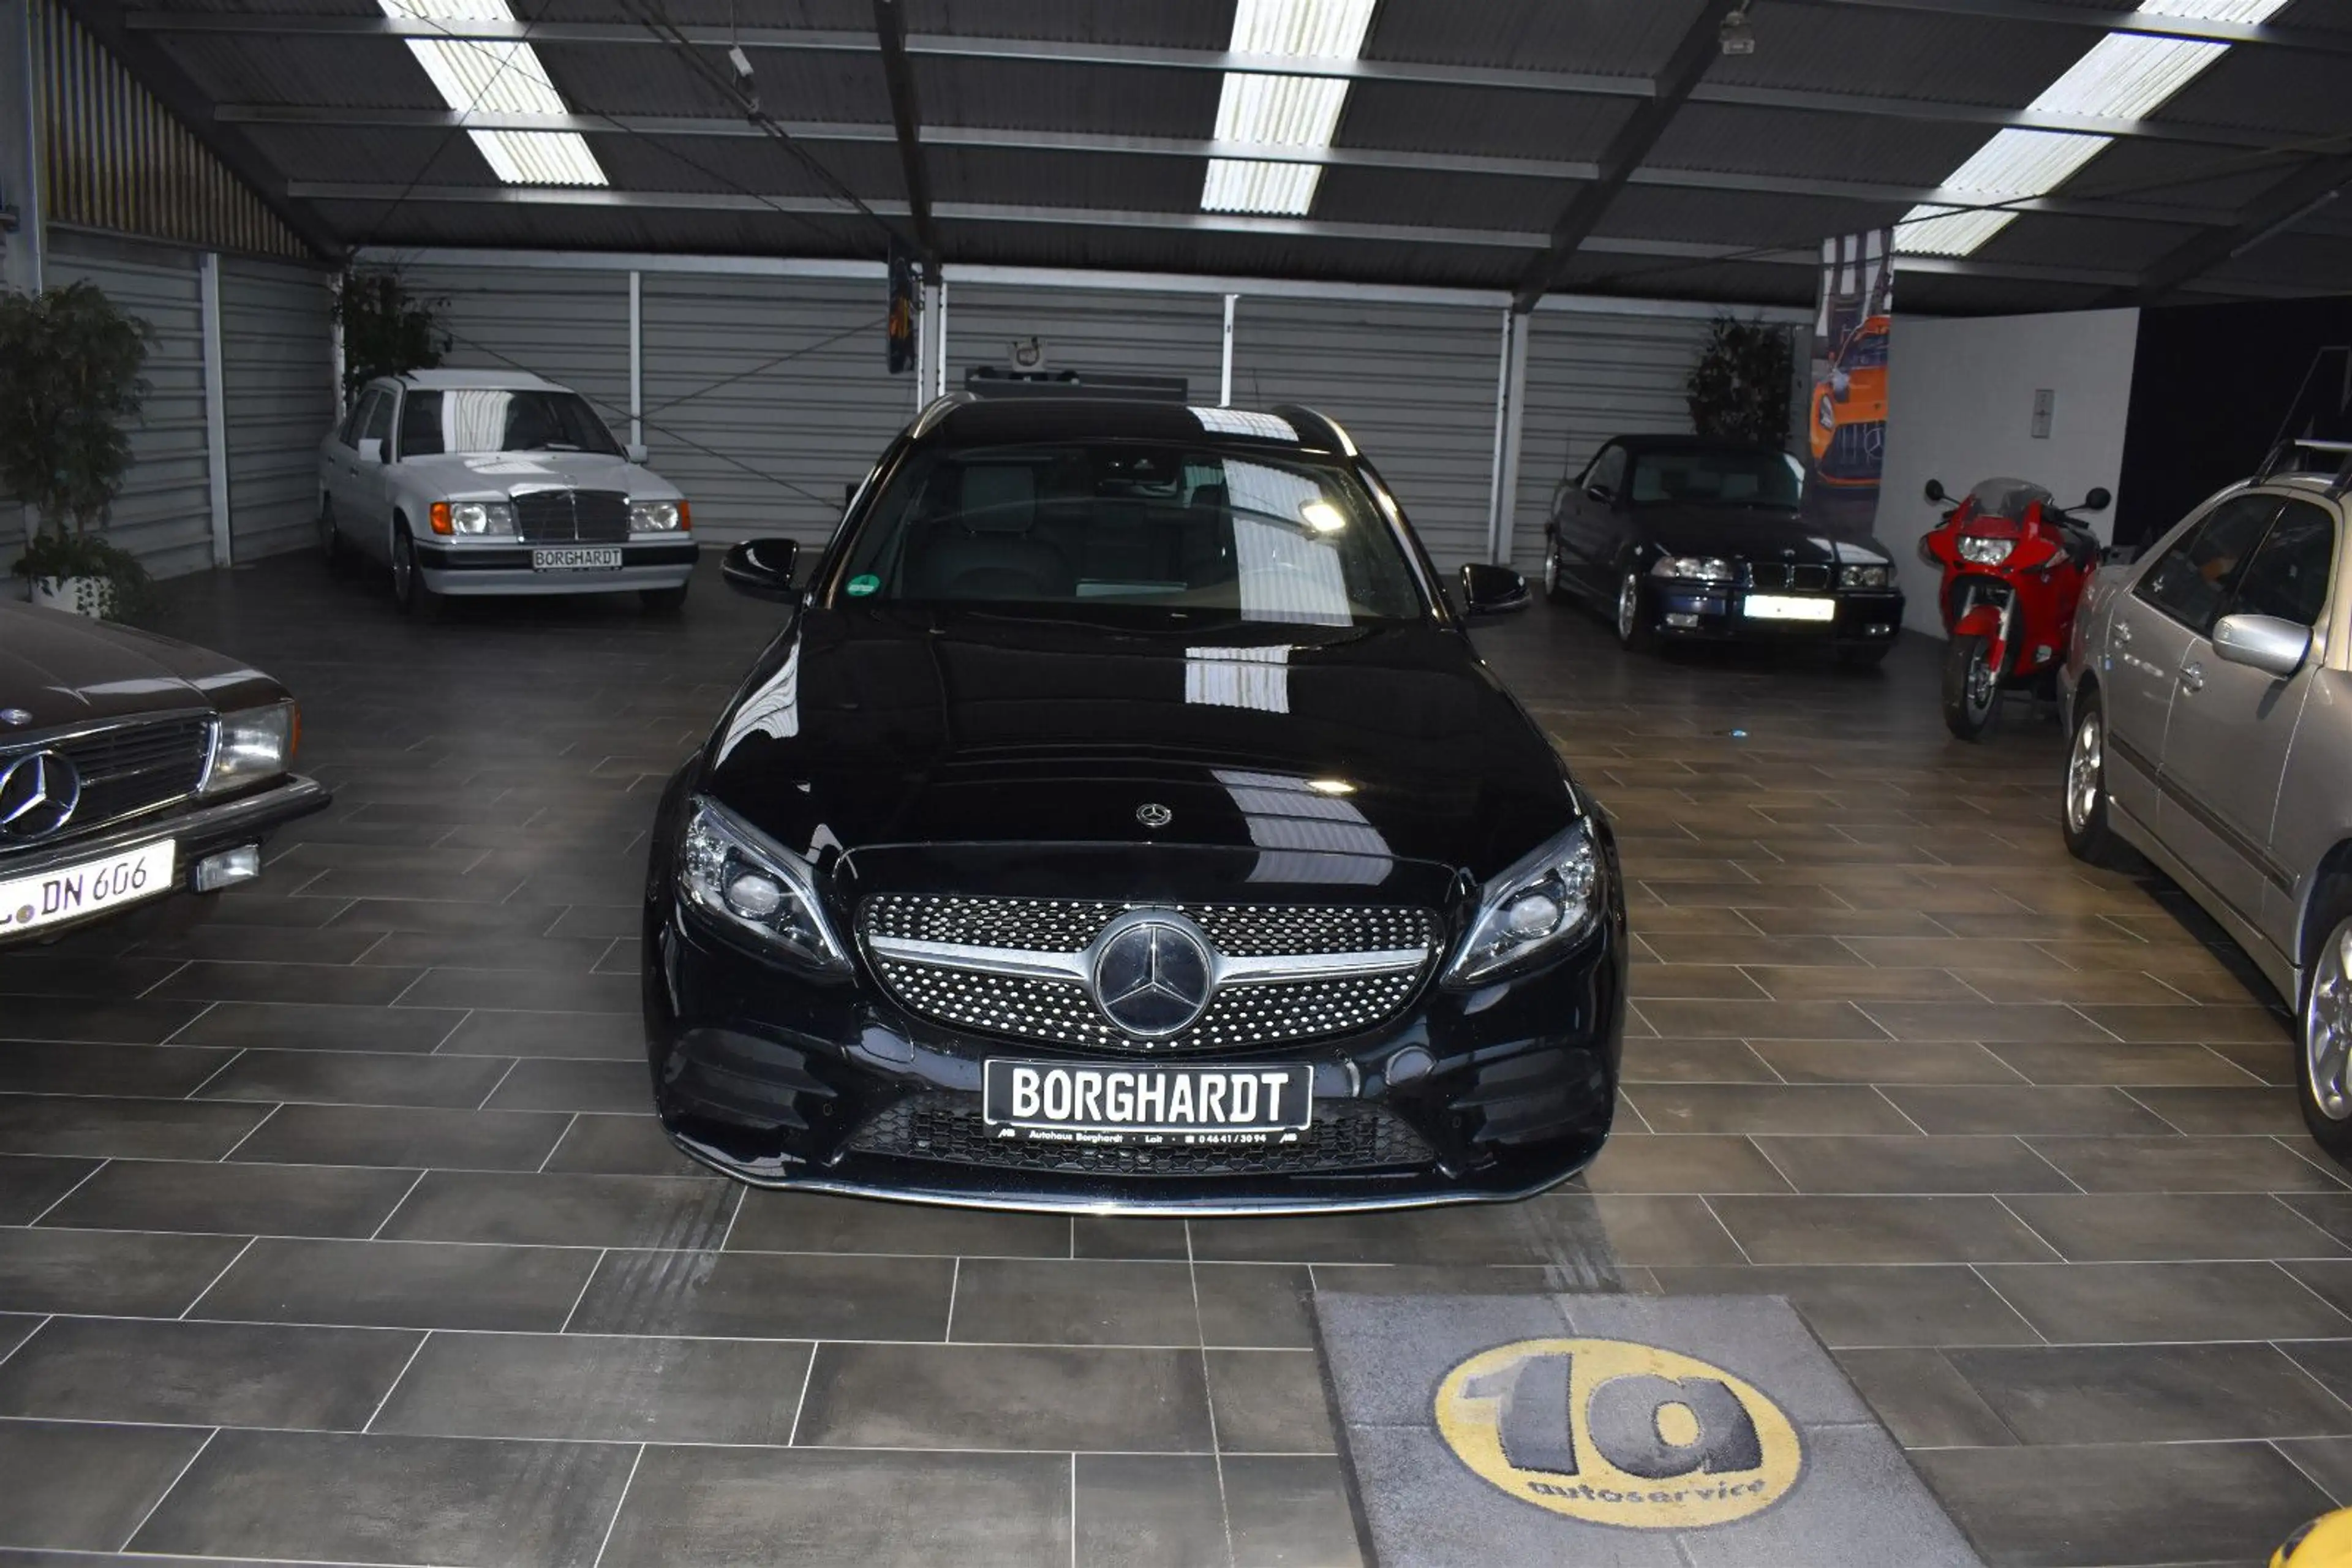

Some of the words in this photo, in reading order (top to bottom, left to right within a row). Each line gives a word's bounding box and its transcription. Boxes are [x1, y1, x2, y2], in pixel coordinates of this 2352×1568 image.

[535, 551, 620, 566] BORGHARDT
[41, 874, 83, 916] DN
[93, 856, 146, 901] 606
[1012, 1067, 1288, 1123] BORGHARDT
[1029, 1130, 1072, 1141] Autohaus
[1076, 1133, 1123, 1144] Borghardt
[1527, 1479, 1765, 1502] autoservice
